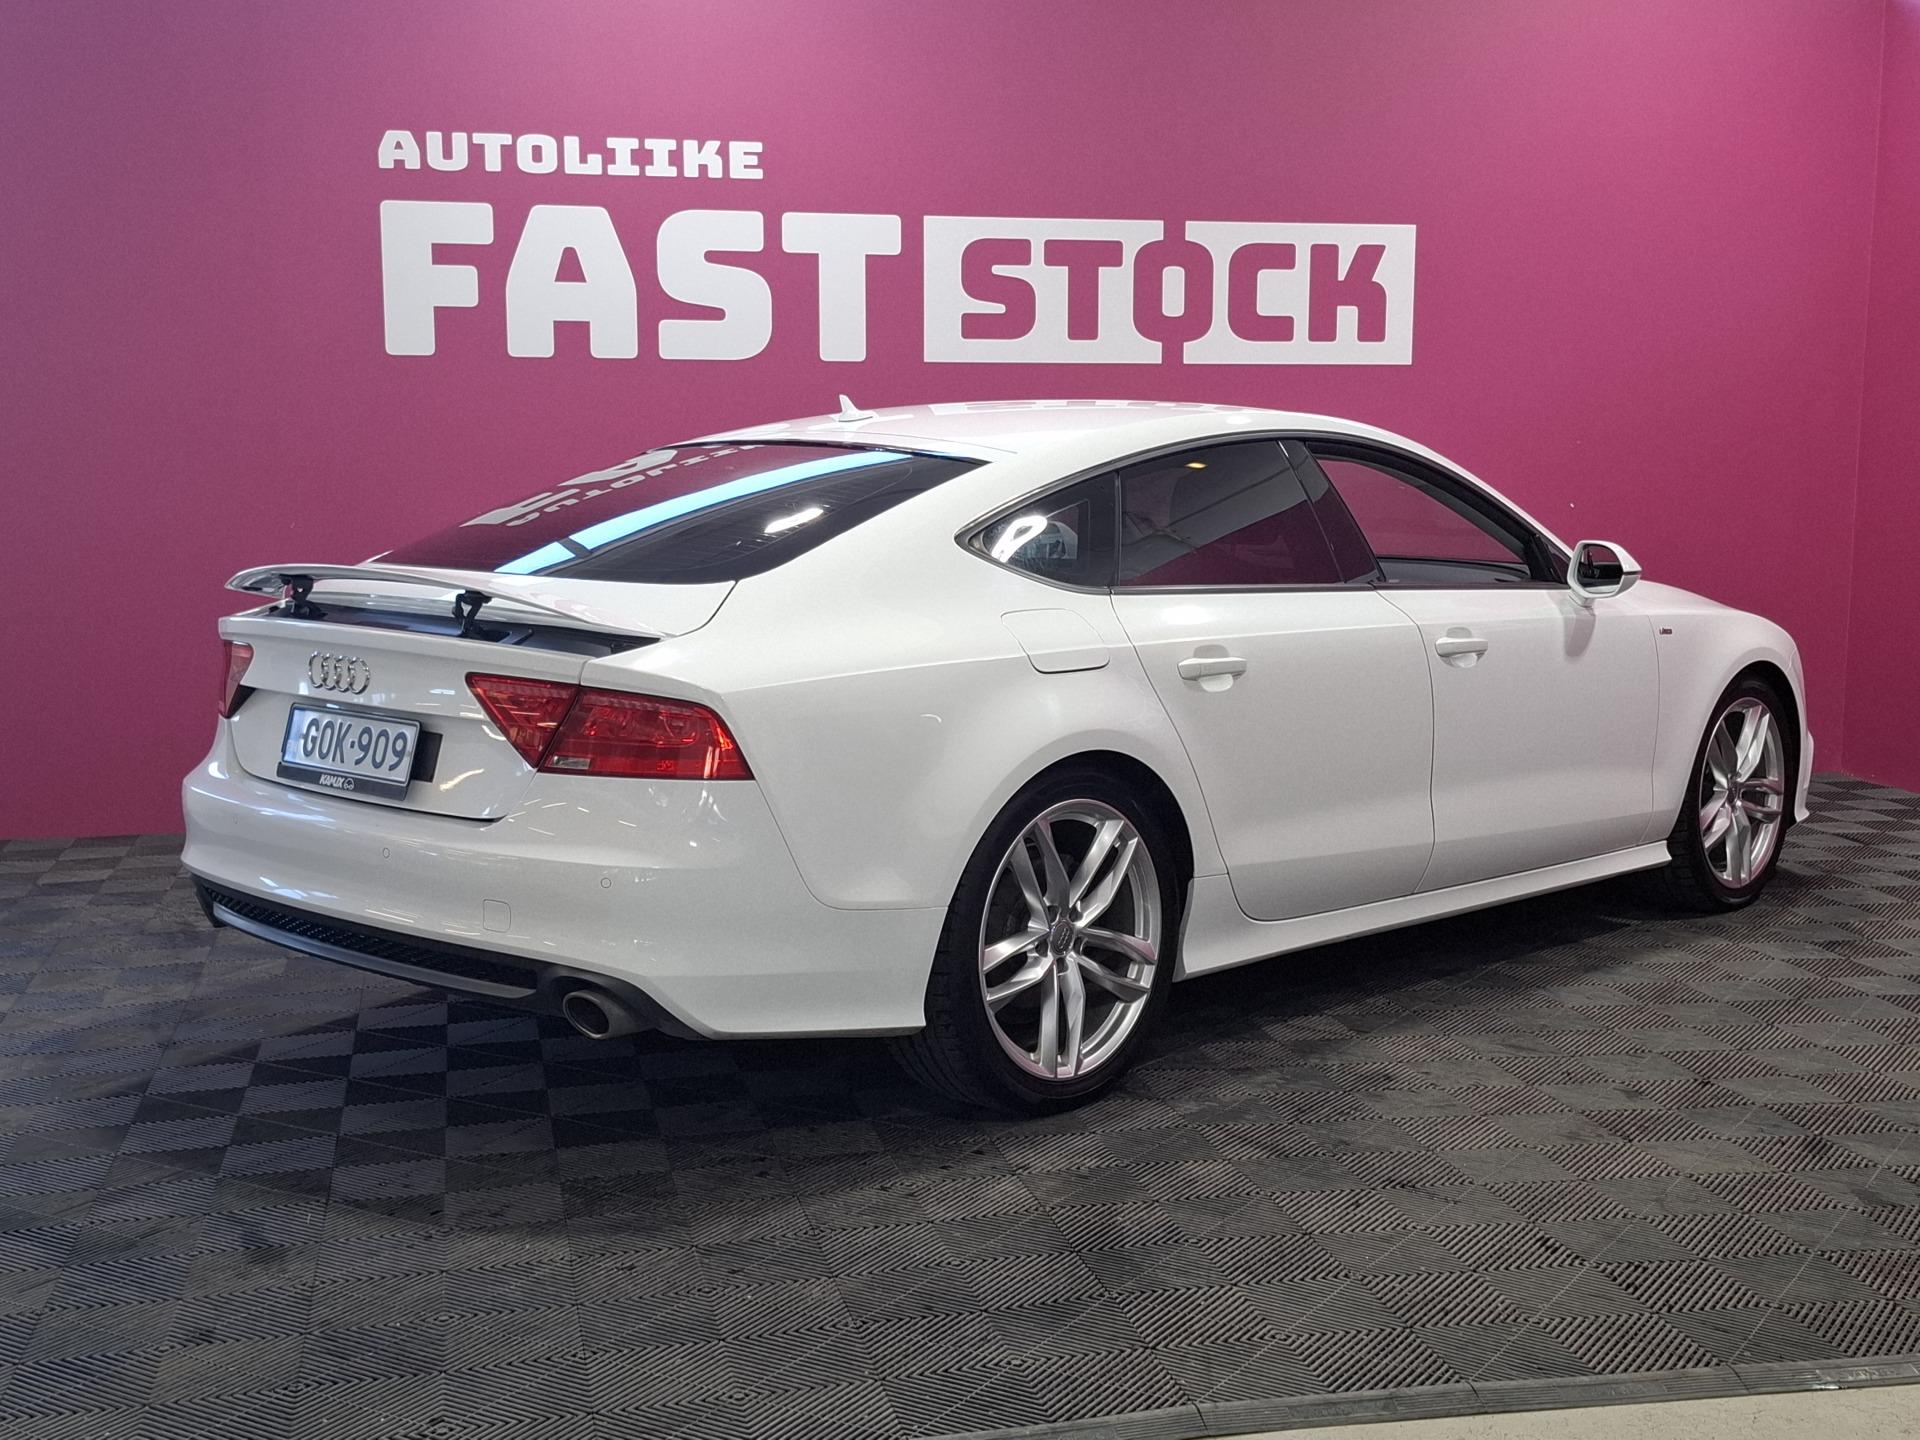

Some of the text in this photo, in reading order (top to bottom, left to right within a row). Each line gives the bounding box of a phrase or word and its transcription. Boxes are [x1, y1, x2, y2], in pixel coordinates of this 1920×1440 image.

[378, 130, 763, 179] AUTOLIIKE
[380, 200, 1388, 361] FAST STOCK
[302, 717, 408, 771] GOK-909
